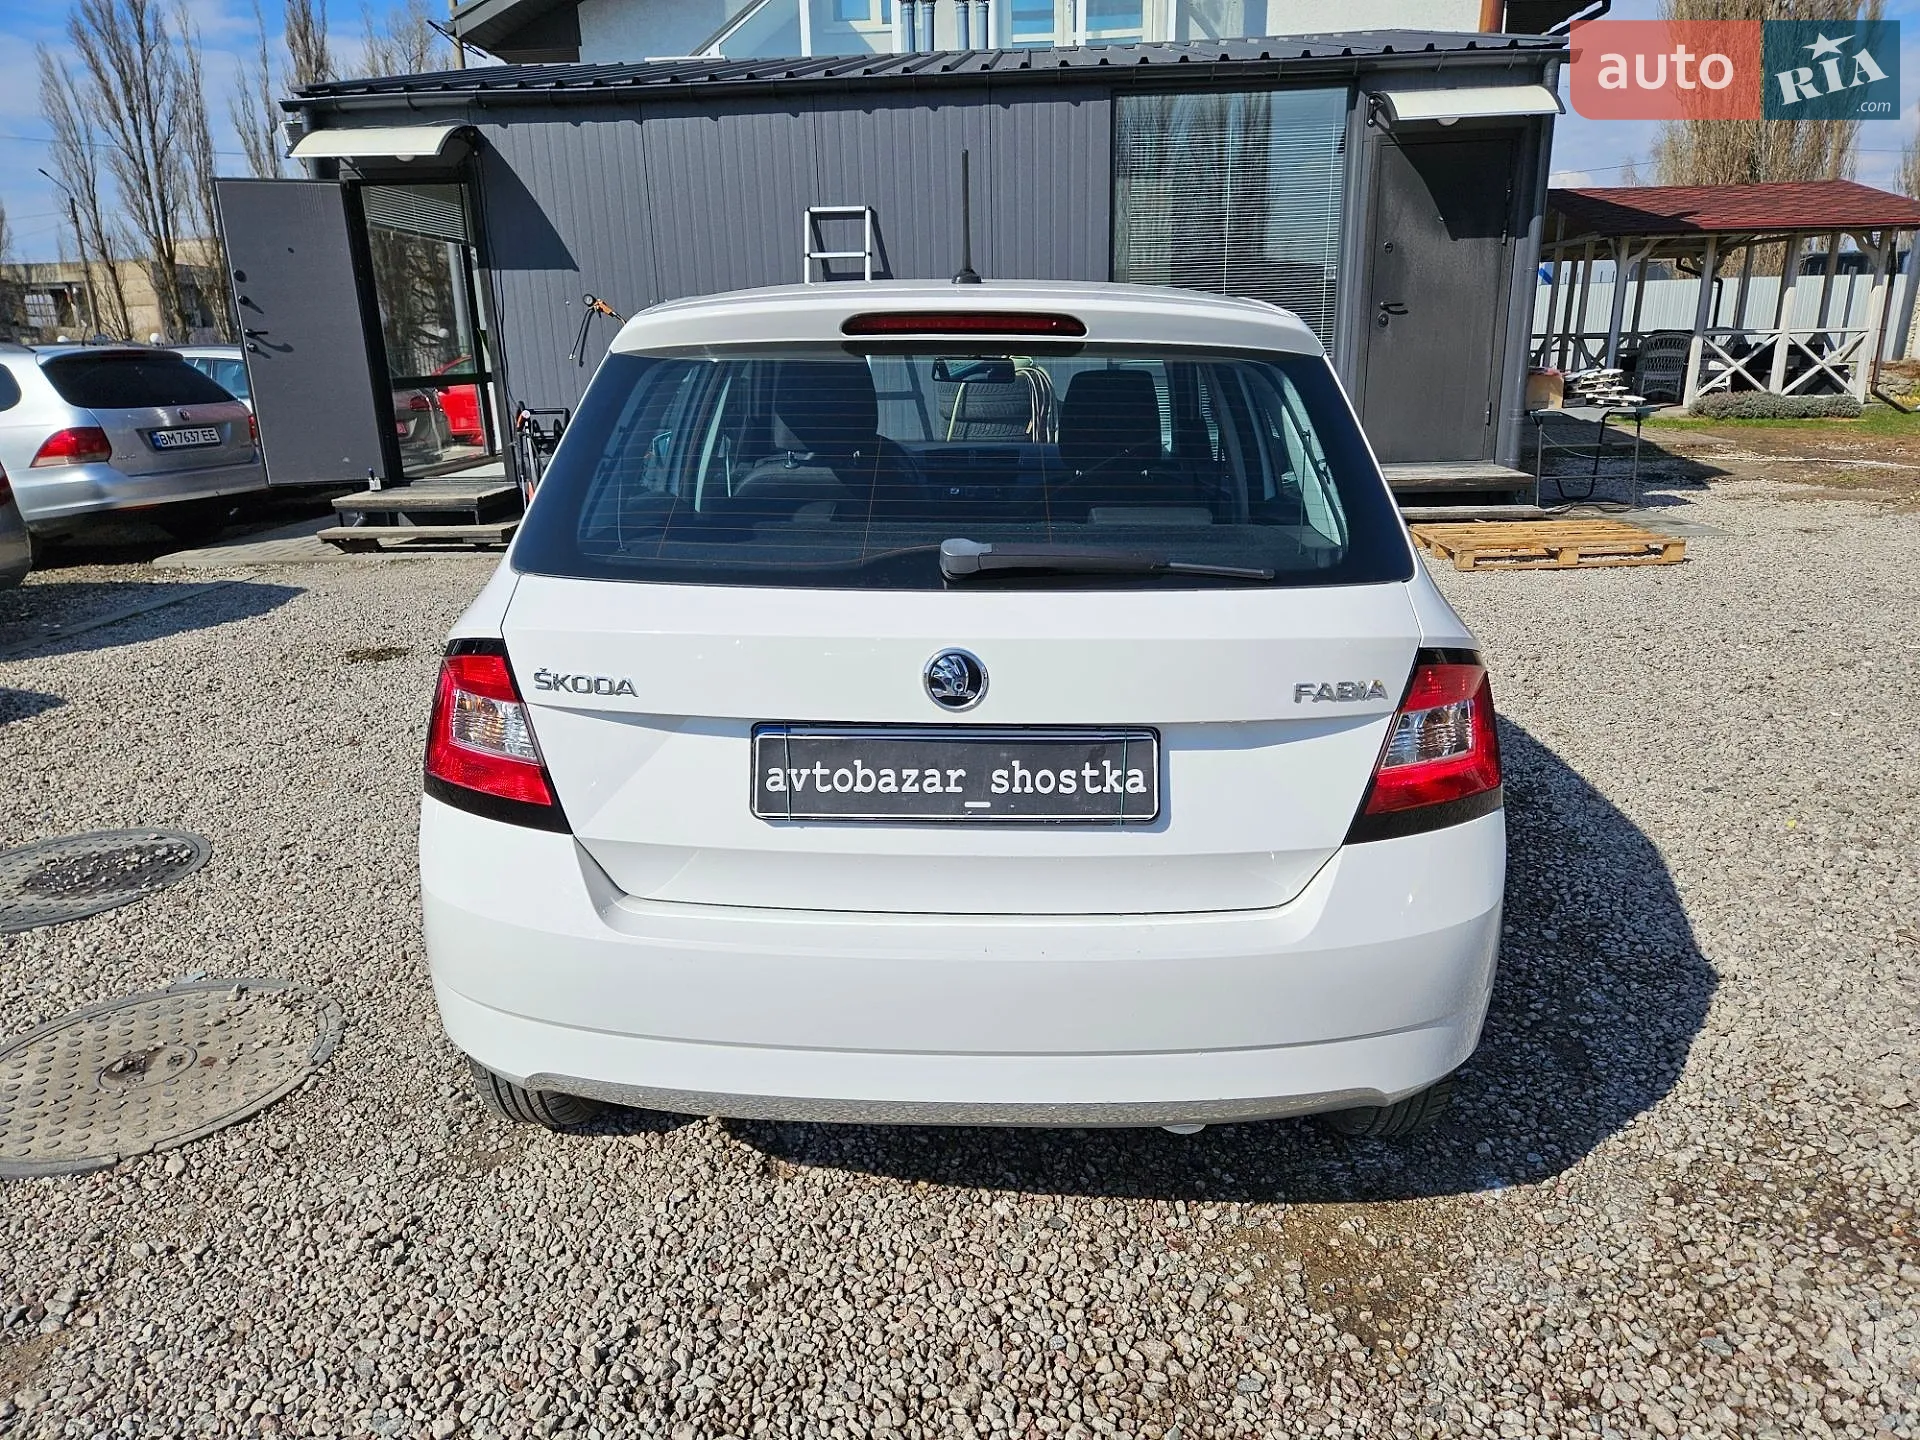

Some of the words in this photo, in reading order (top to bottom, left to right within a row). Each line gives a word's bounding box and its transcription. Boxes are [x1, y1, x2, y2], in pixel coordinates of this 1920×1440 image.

[159, 433, 178, 446] BM
[177, 431, 200, 444] 7637
[201, 429, 217, 441] EE
[533, 667, 639, 698] ŠKODA
[1293, 679, 1389, 704] FABIA
